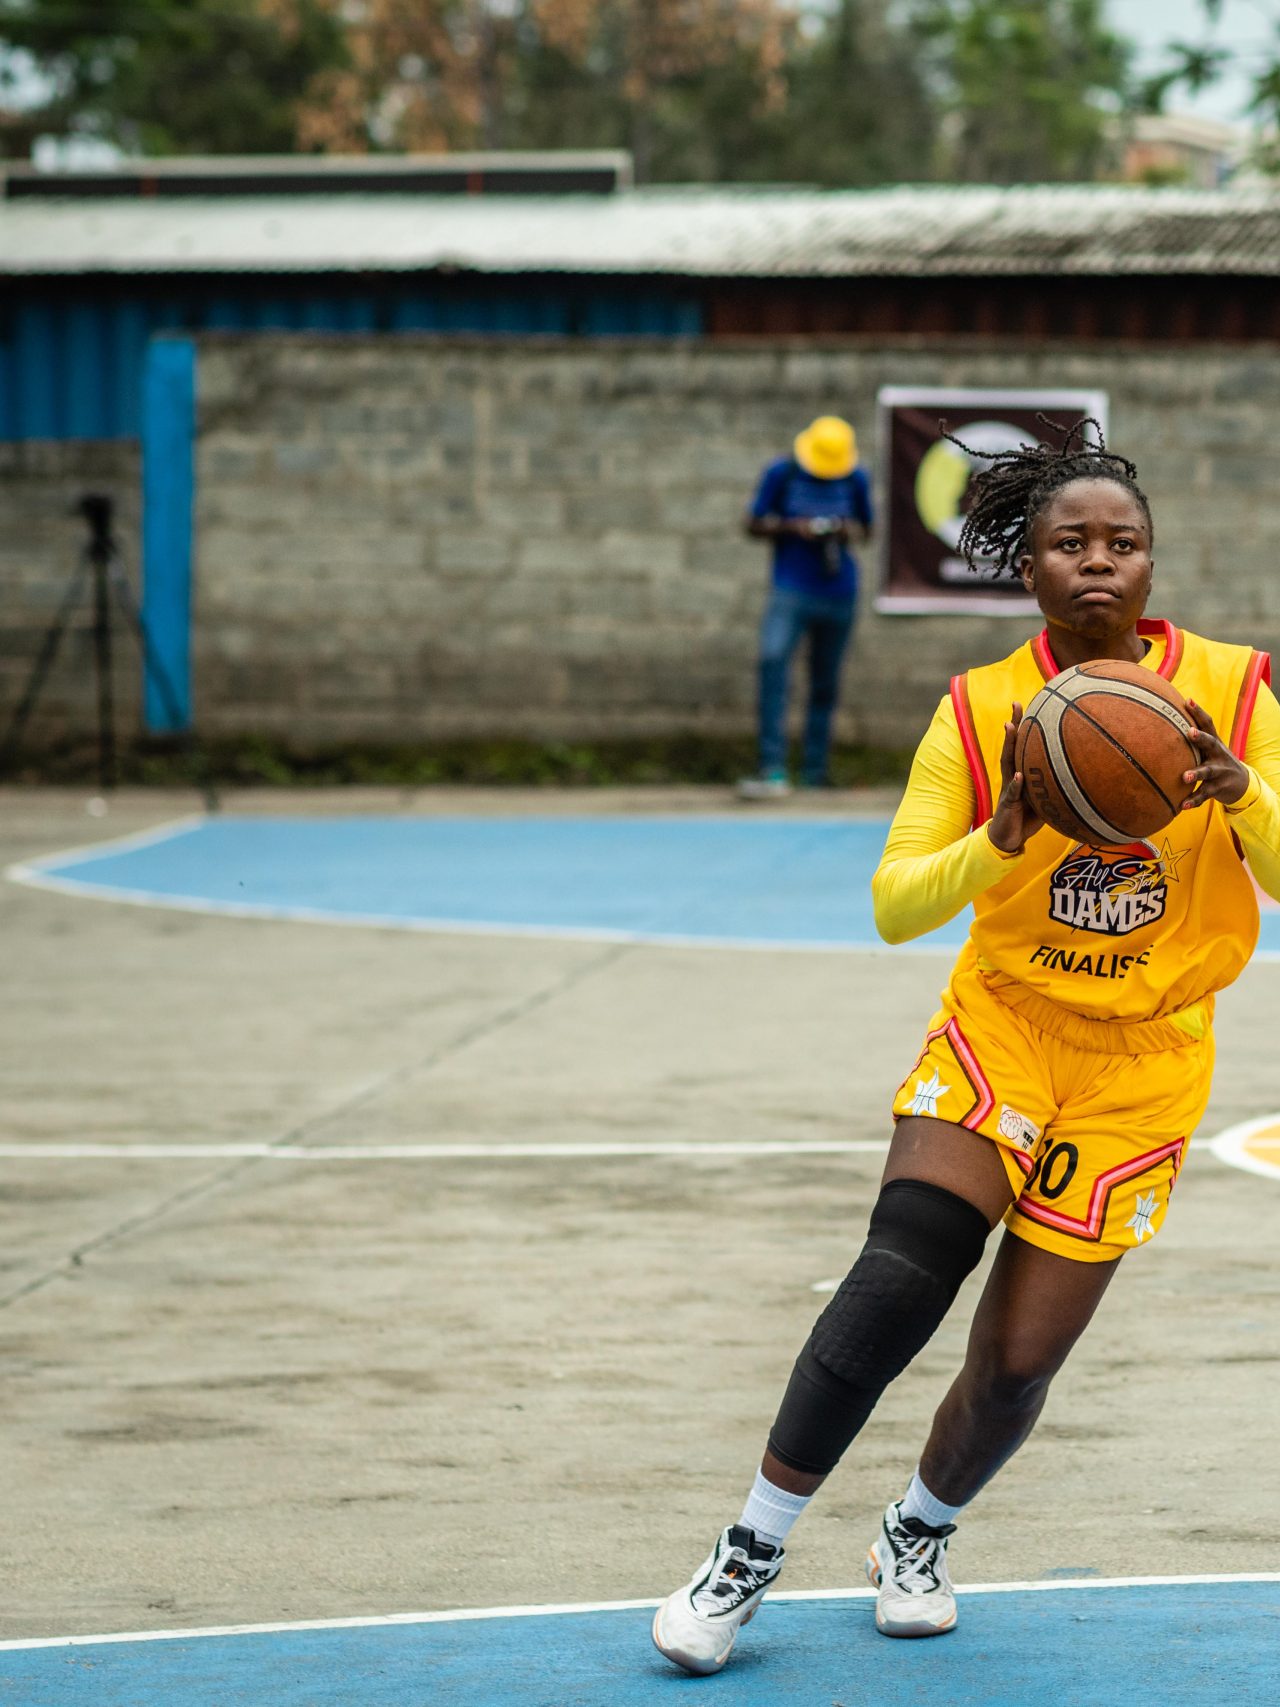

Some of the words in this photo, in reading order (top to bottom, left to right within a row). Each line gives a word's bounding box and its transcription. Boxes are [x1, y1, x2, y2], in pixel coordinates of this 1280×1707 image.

[1054, 858, 1109, 891] All
[1104, 861, 1154, 895] Star
[1052, 887, 1165, 932] DAMES
[1024, 1138, 1078, 1199] 10
